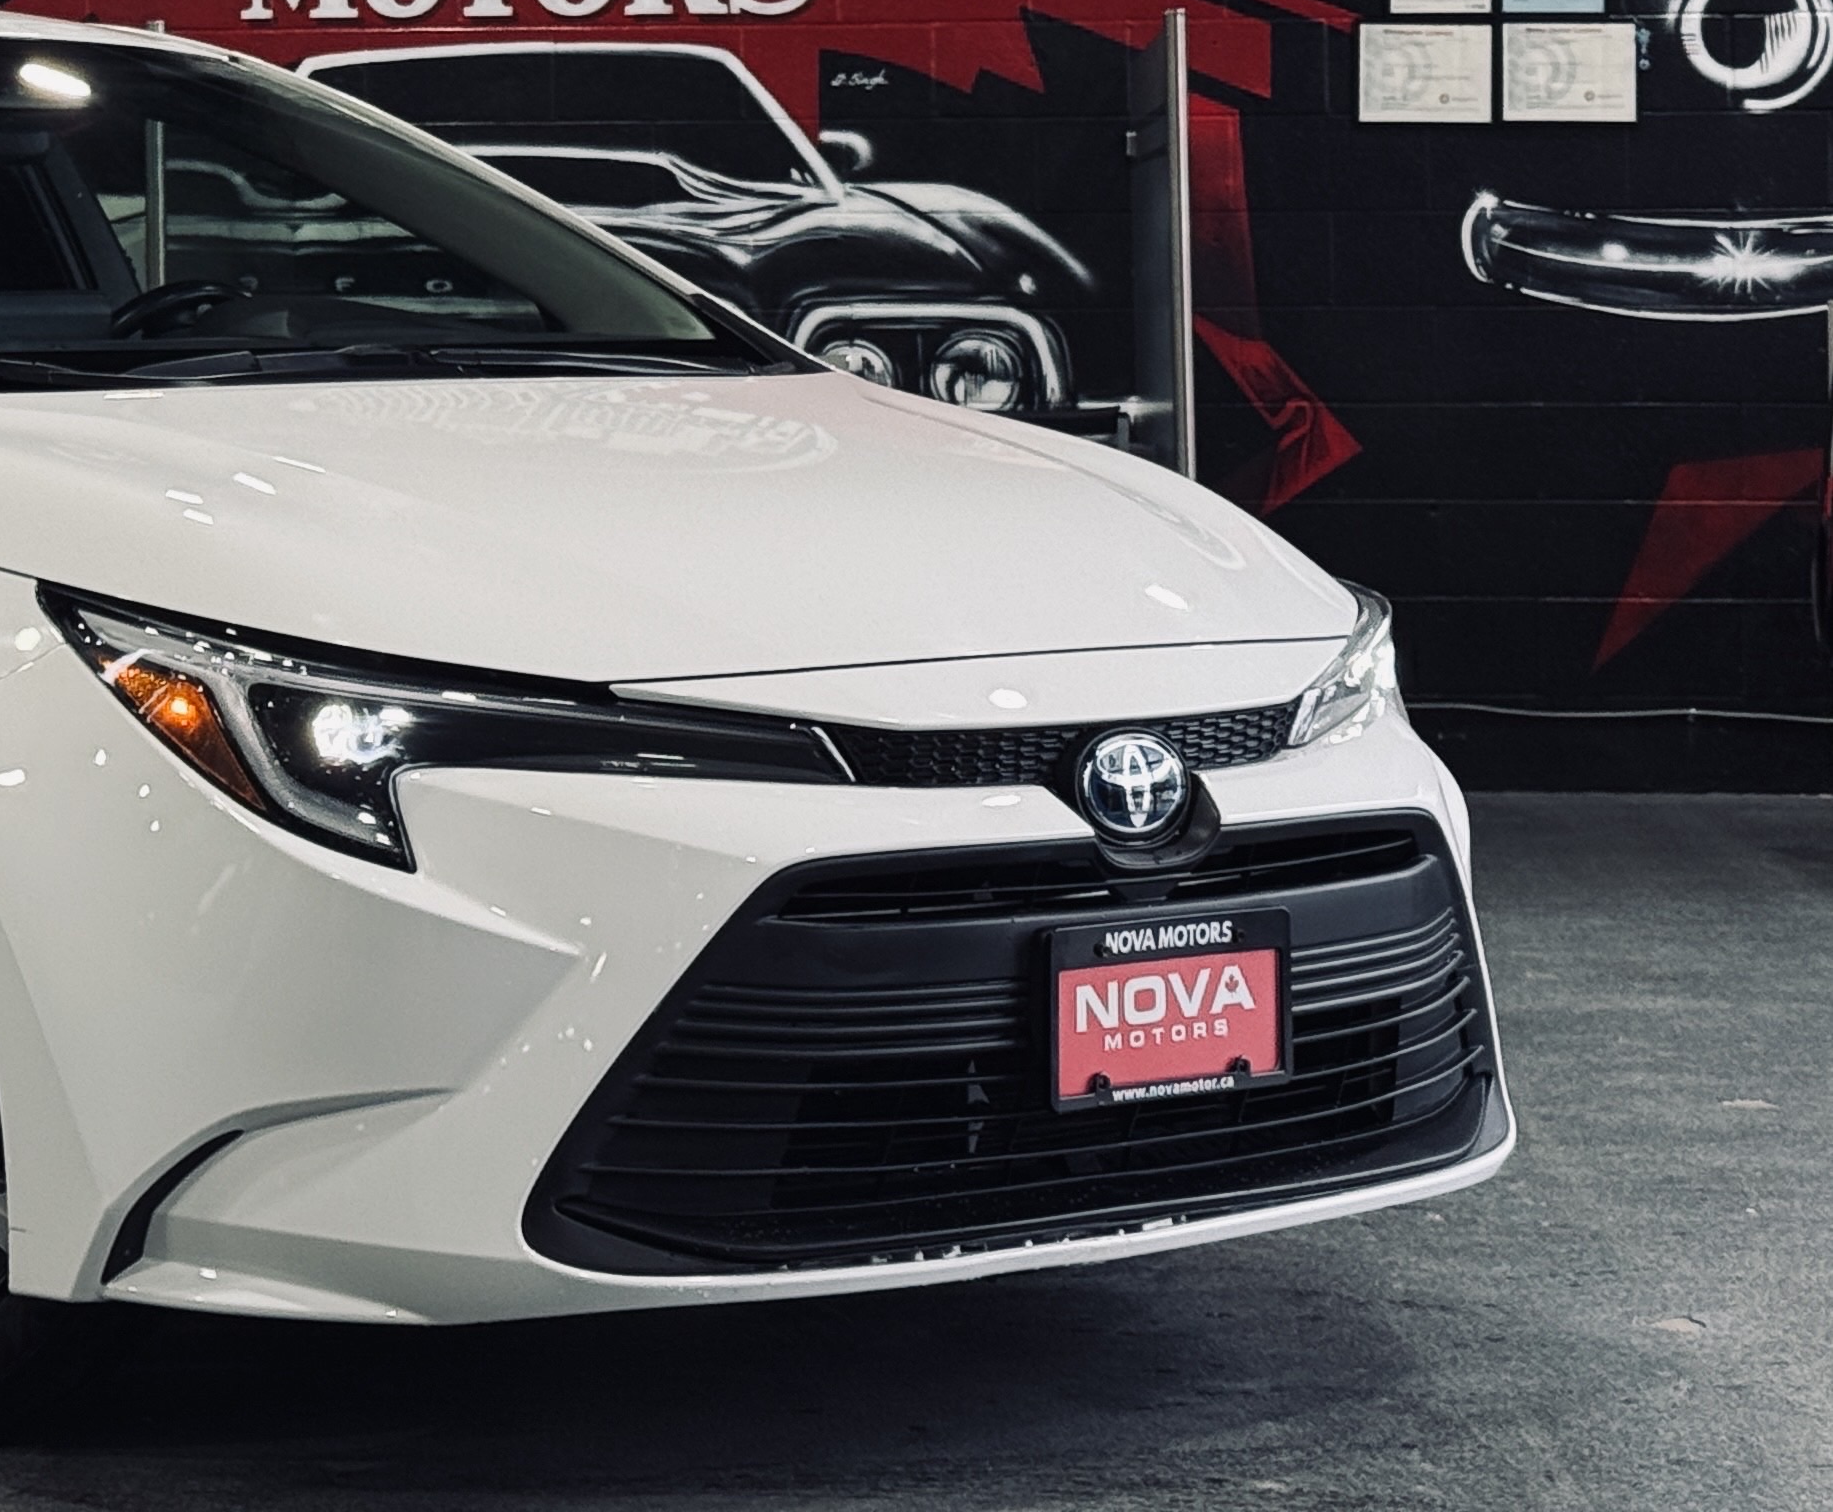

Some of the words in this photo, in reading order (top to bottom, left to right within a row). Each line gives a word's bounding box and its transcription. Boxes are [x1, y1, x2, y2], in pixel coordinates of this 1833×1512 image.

[1105, 928, 1156, 954] NOVA
[1158, 920, 1233, 949] MOTORS
[1075, 964, 1256, 1033] NOVA
[1103, 1018, 1230, 1052] MOTORS
[1112, 1076, 1235, 1102] www.novamotor.ca
